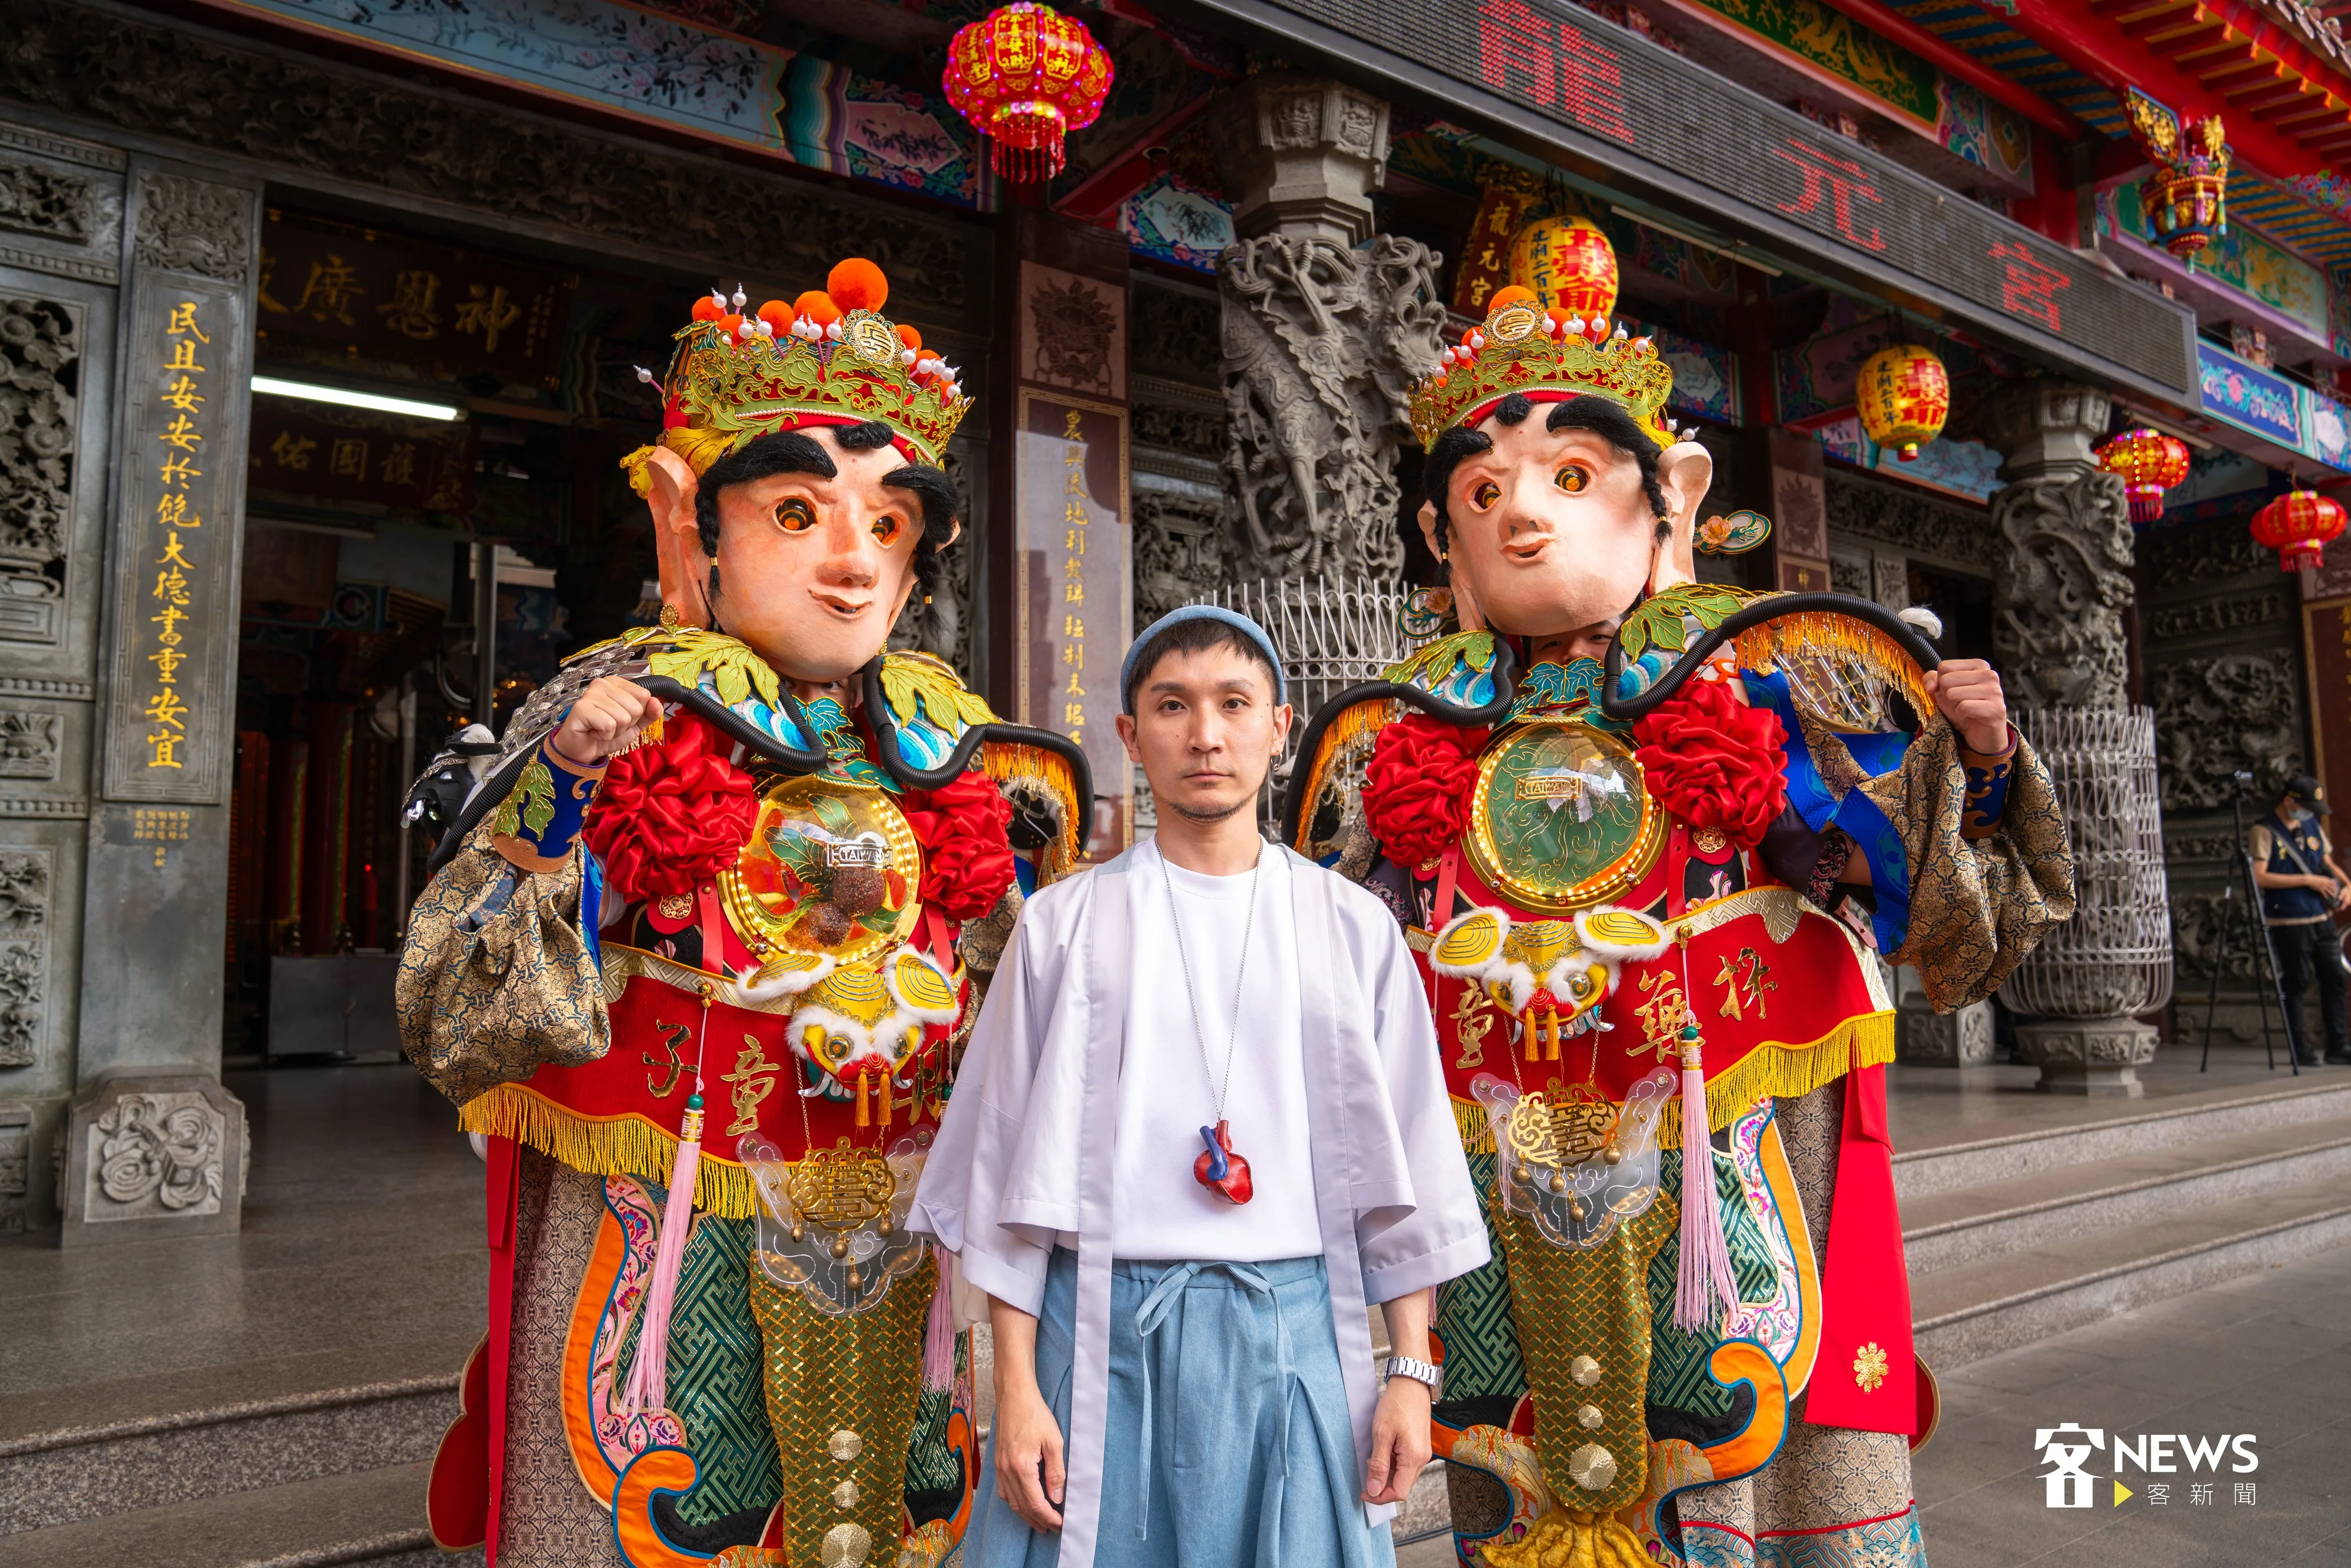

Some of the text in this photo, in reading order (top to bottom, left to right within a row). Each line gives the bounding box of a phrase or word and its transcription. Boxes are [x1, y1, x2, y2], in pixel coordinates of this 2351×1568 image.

[1477, 0, 2072, 332] 龍元宮
[1470, 200, 1512, 307] 龍元宮
[1528, 782, 1568, 794] TAIWAN
[842, 849, 882, 862] TAIWAN
